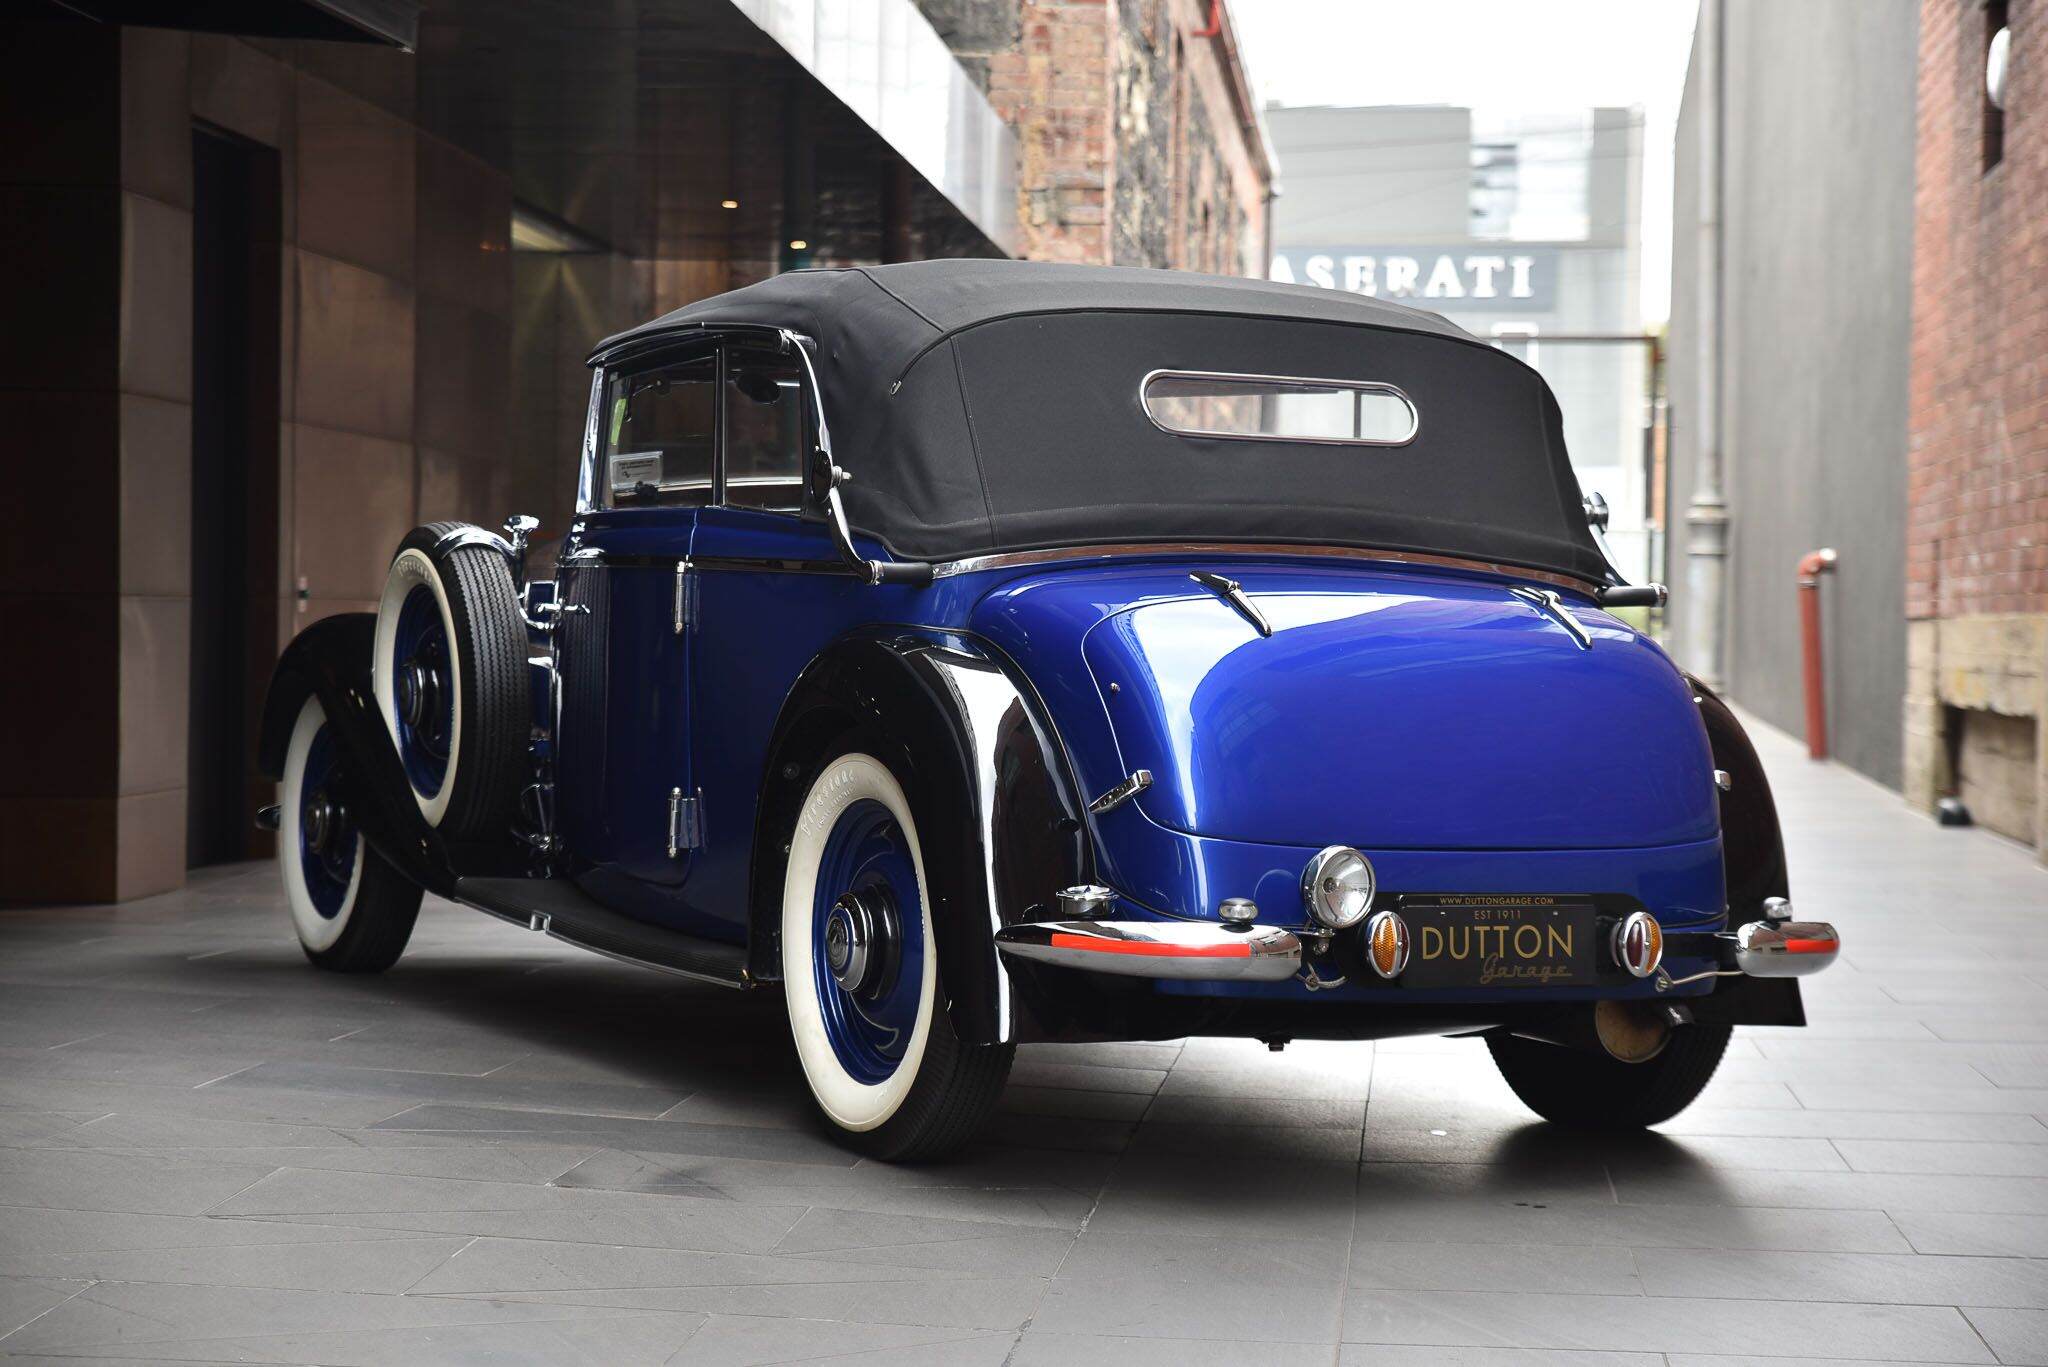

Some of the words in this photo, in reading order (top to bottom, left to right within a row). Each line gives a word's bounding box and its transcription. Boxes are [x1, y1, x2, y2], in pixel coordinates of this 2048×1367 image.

[1439, 896, 1555, 905] WWW.DUTTONGARAGE.COM
[1474, 910, 1491, 920] EST
[1497, 910, 1521, 920] 1911
[1422, 924, 1574, 960] DUTTON
[1480, 952, 1573, 984] Garage
